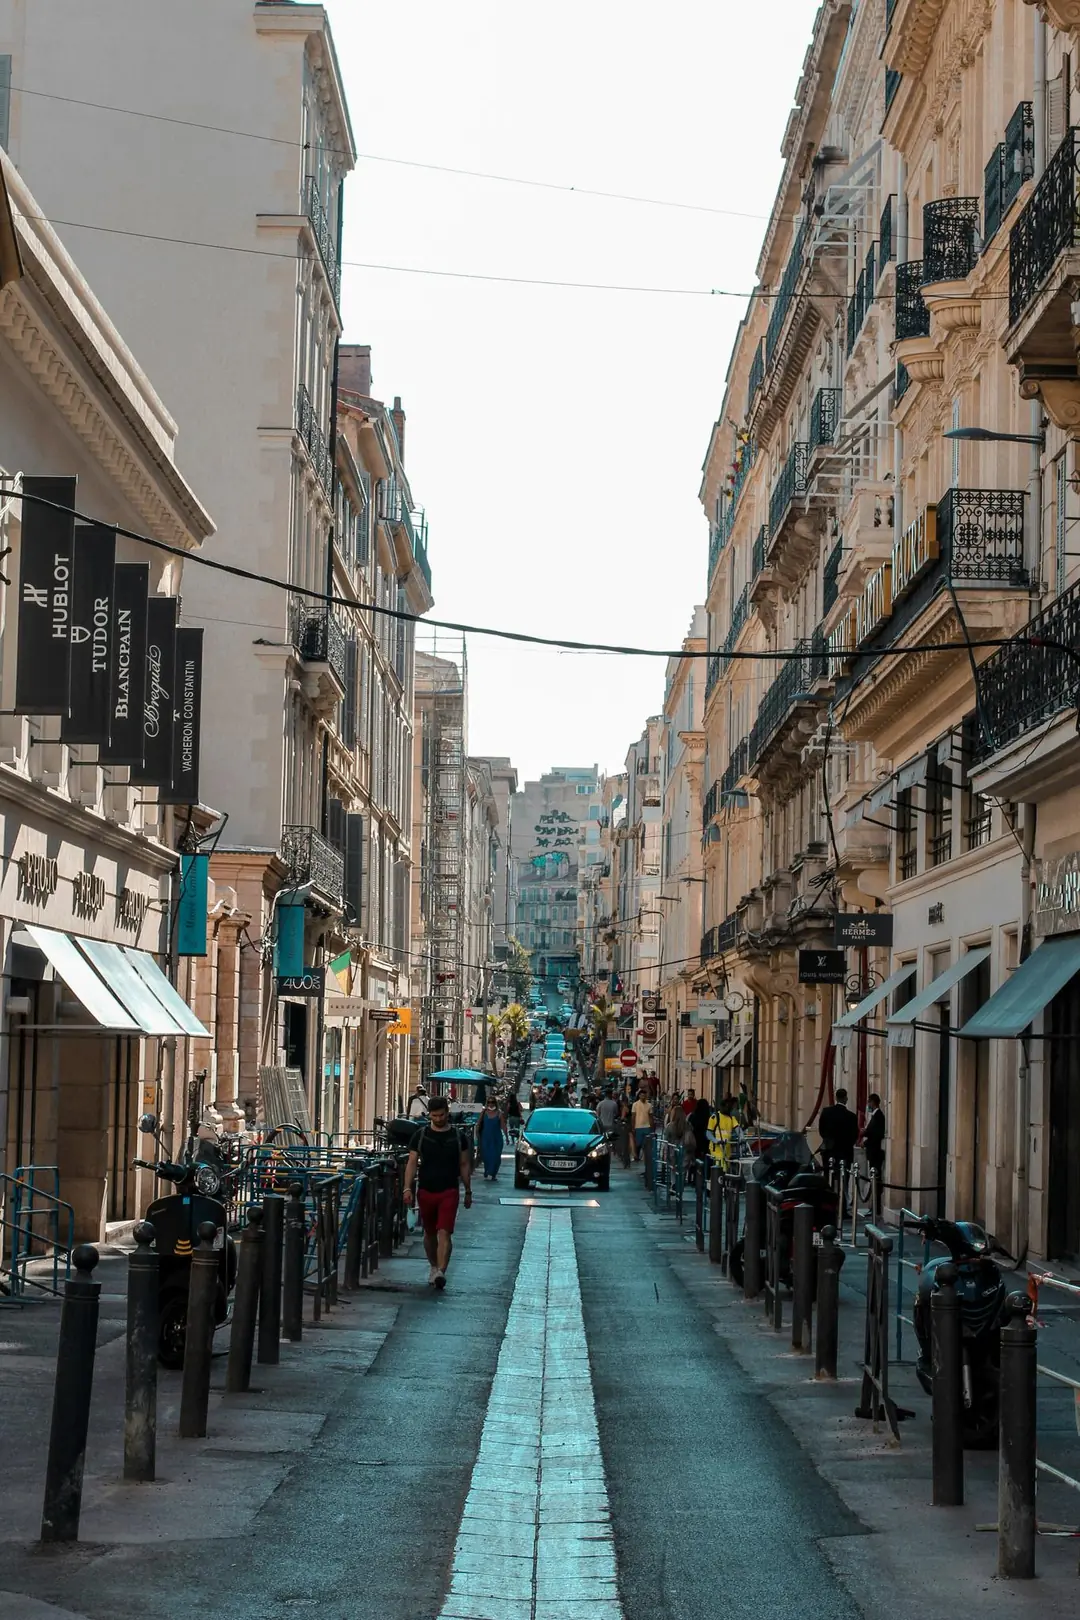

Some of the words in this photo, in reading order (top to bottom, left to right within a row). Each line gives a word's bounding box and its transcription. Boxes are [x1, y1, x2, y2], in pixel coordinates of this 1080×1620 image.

[52, 554, 70, 639] HUBLOT
[92, 596, 109, 673] TUDOR
[115, 608, 131, 719] BLANCPAIN
[144, 644, 170, 738] Breguet
[184, 660, 195, 721] CONSTANTIN
[182, 723, 193, 772] VACHERON
